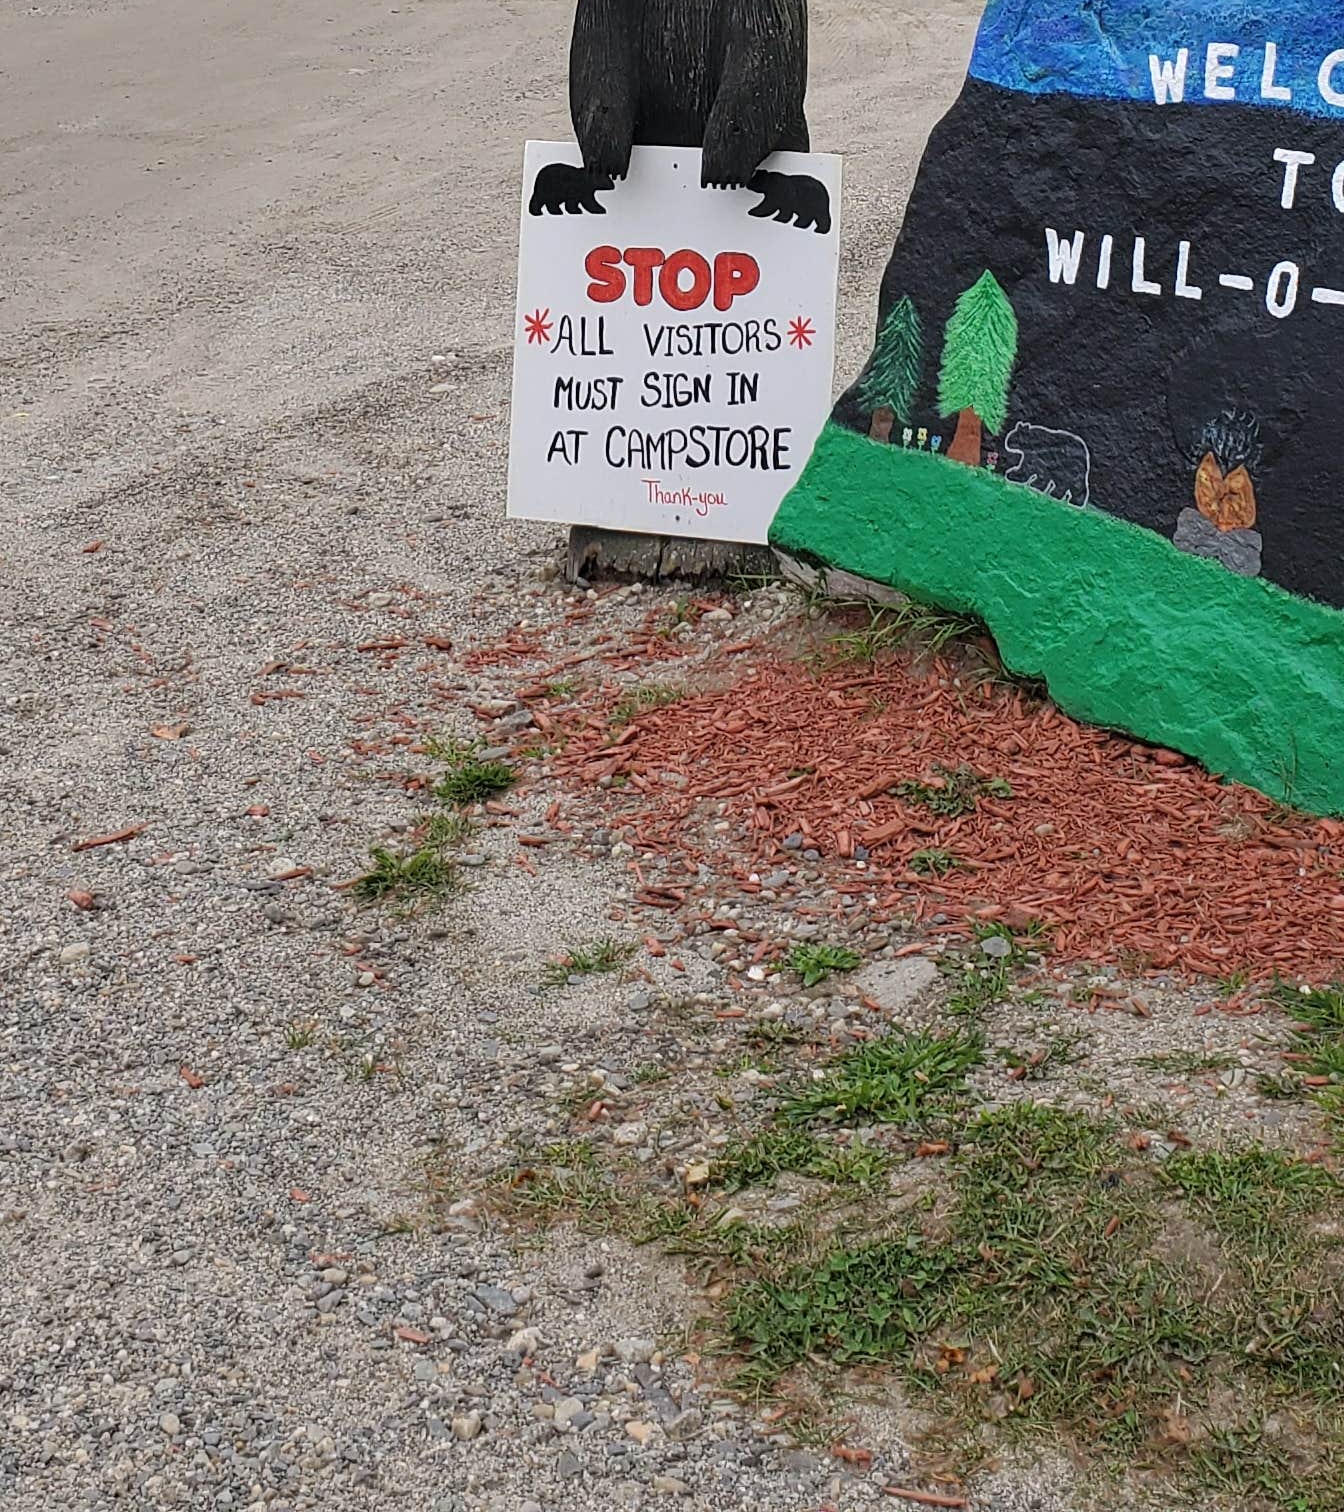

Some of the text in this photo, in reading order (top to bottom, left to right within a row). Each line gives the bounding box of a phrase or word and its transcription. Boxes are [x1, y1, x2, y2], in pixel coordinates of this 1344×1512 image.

[585, 245, 760, 311] STOP
[551, 315, 782, 357] ALL VISITORS
[553, 372, 759, 411] MUST SIGN IN
[547, 424, 792, 470] AT CAMPSTORE
[641, 479, 729, 516] Thank-you
